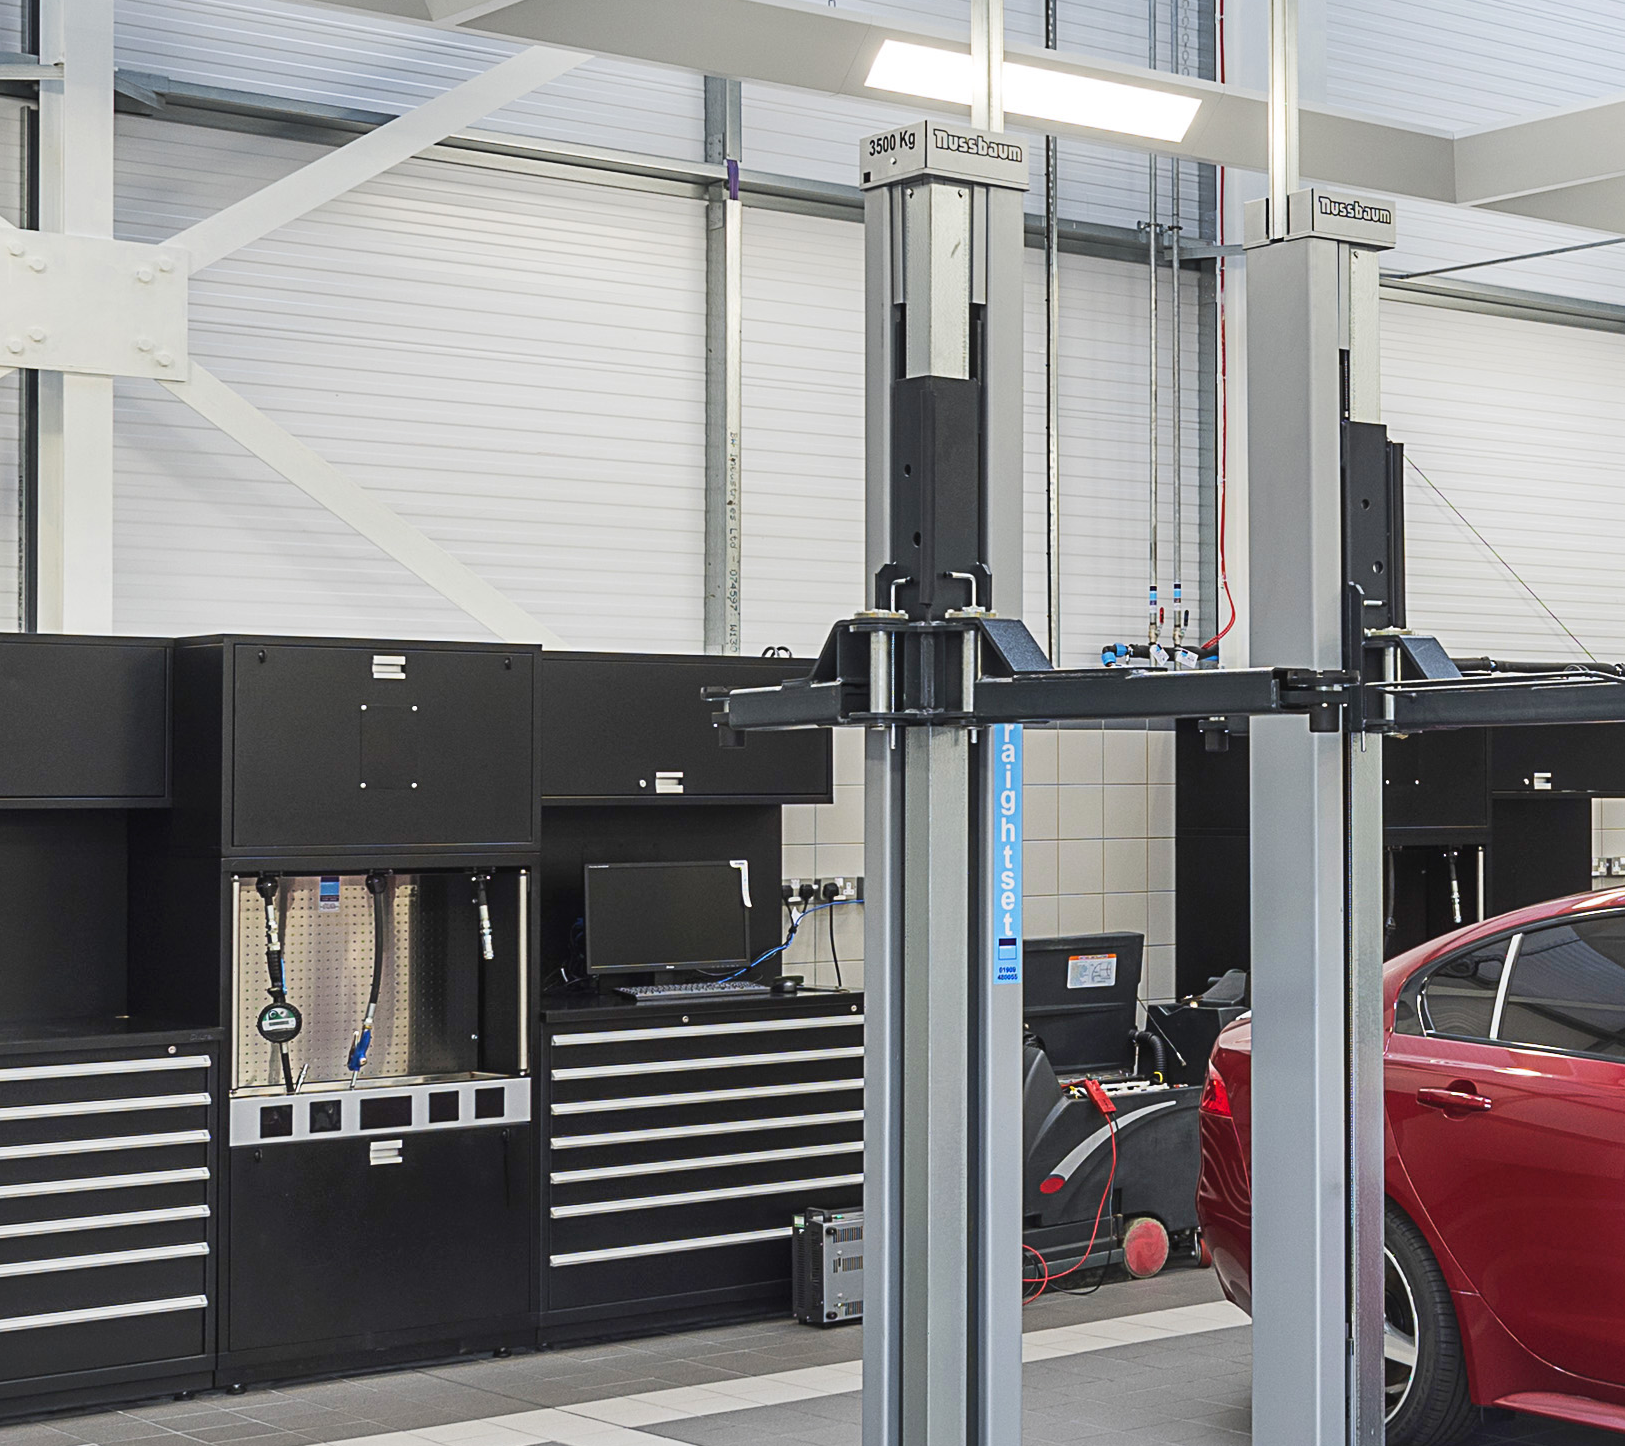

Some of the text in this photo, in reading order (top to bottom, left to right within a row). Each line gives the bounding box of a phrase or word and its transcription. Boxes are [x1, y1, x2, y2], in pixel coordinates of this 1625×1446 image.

[869, 130, 916, 158] 3500 Kg
[1000, 724, 1017, 937] raightset
